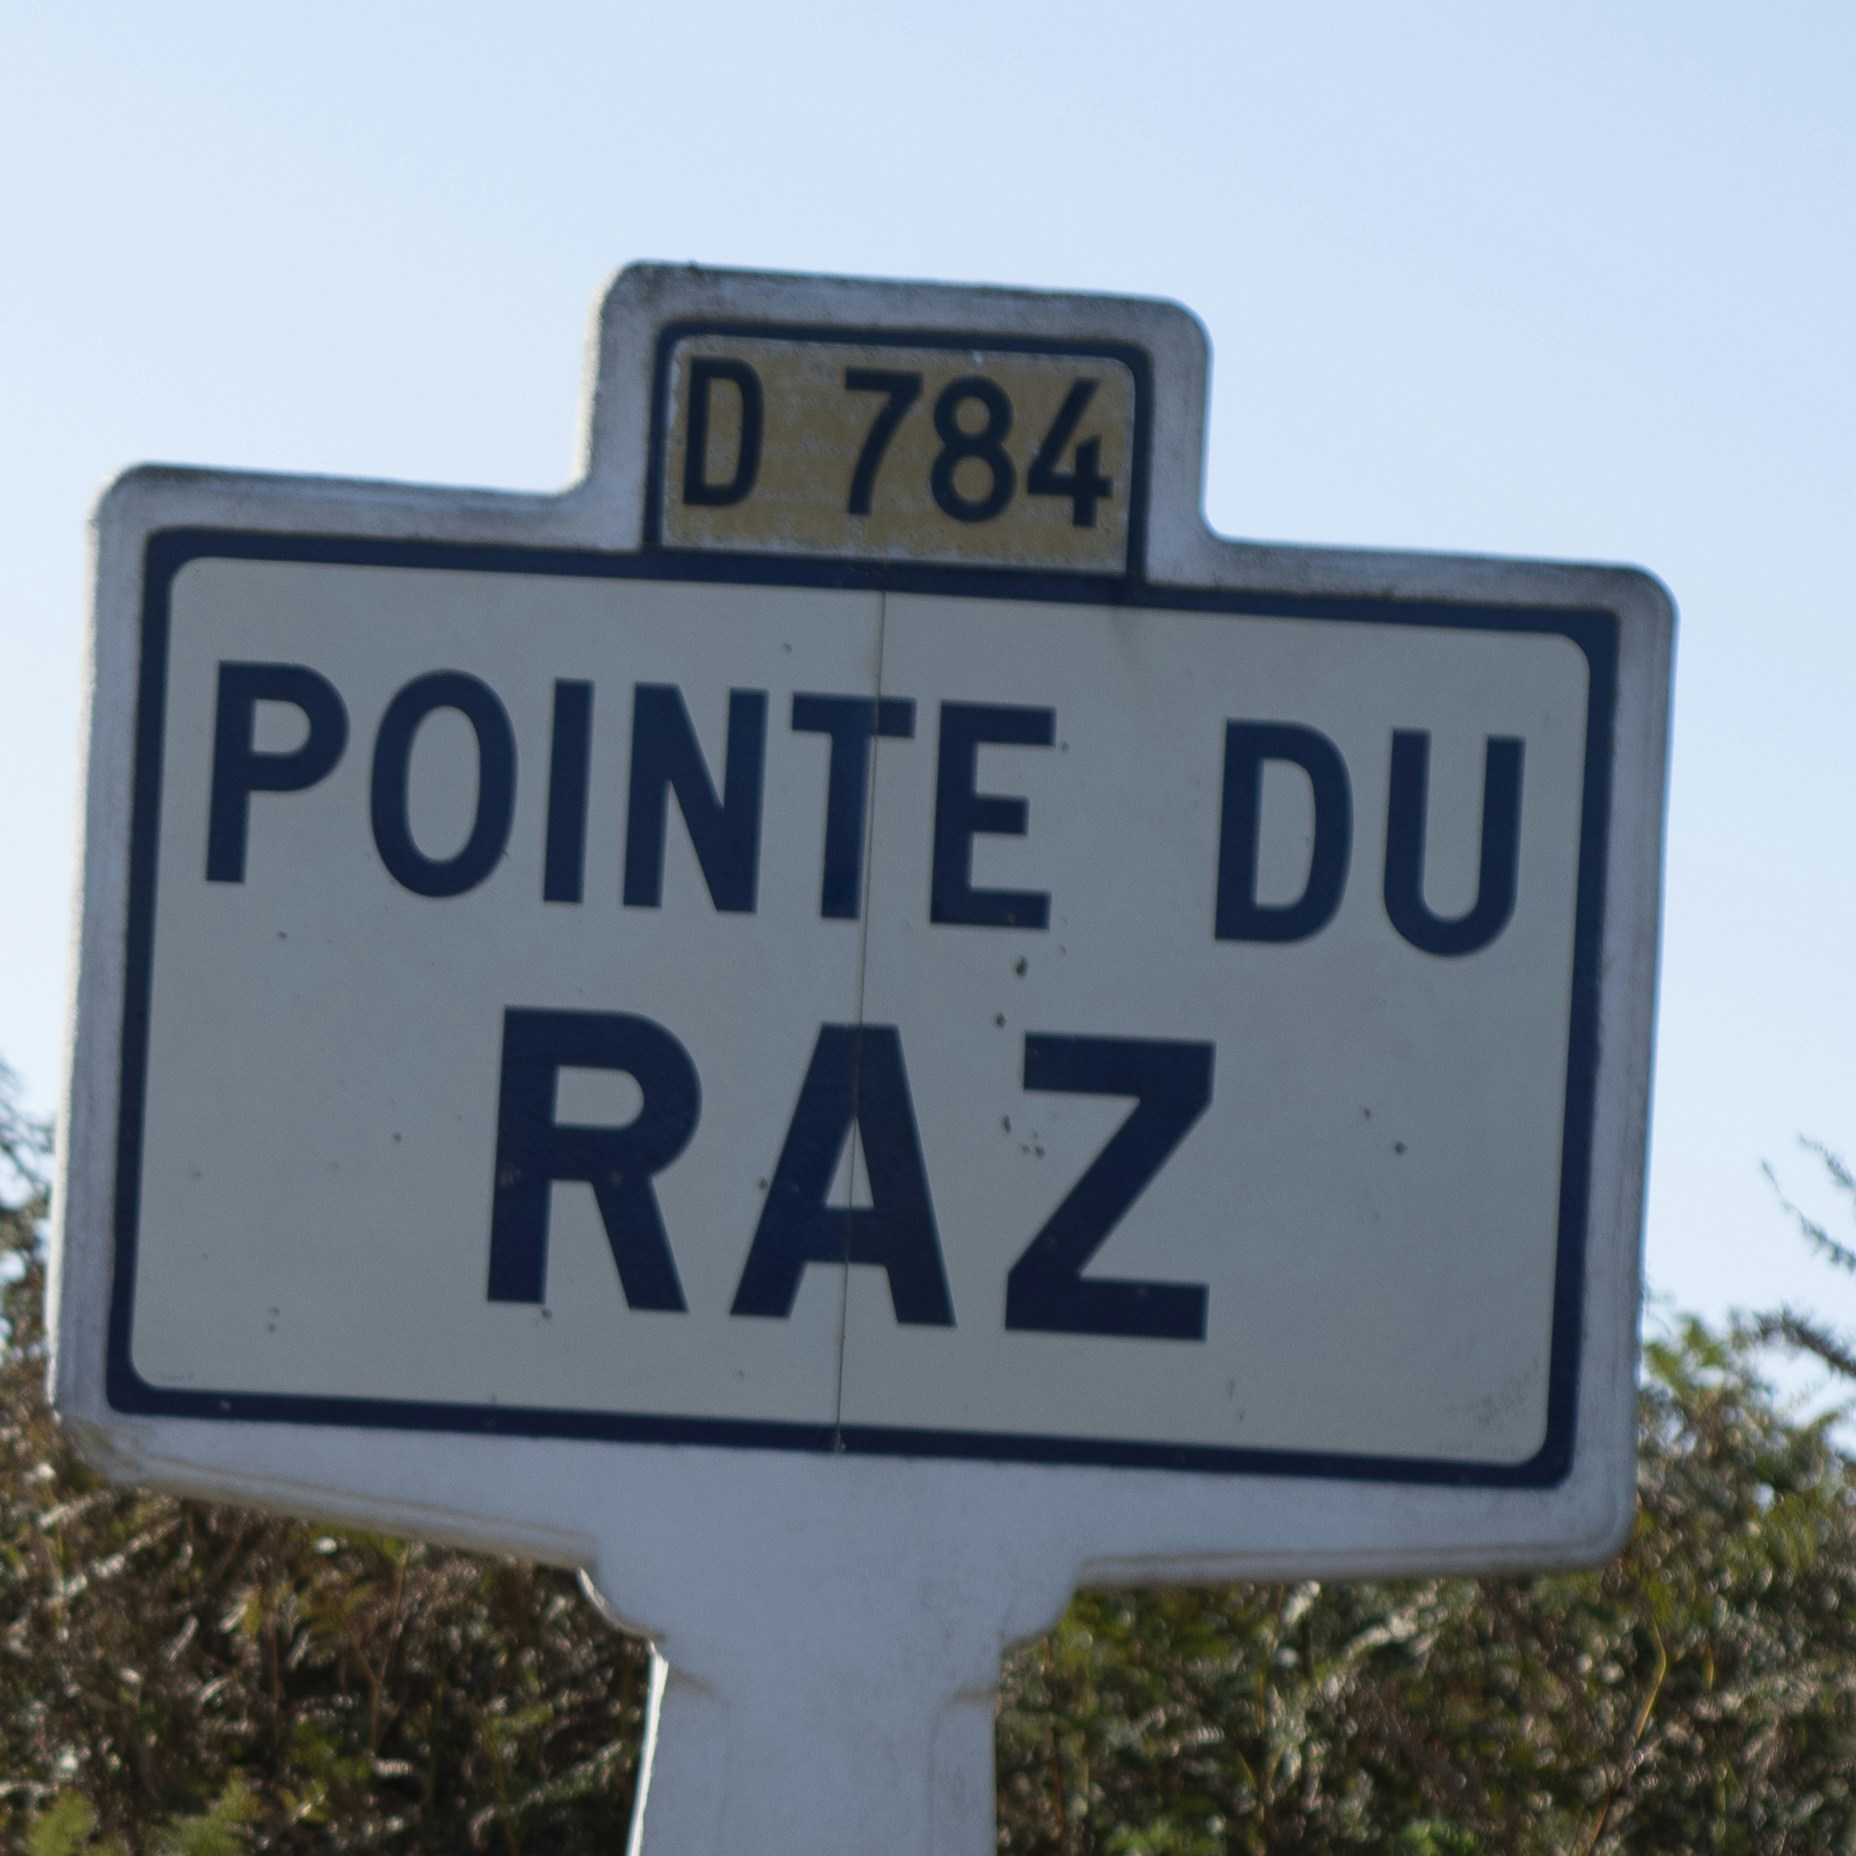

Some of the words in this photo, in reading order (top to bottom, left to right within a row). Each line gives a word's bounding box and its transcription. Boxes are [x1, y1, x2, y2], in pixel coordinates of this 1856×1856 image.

[681, 355, 766, 510] D
[843, 365, 1115, 530] 784
[205, 660, 1058, 931] POINTE
[1213, 718, 1526, 959] DU
[486, 1006, 1218, 1343] RAZ
